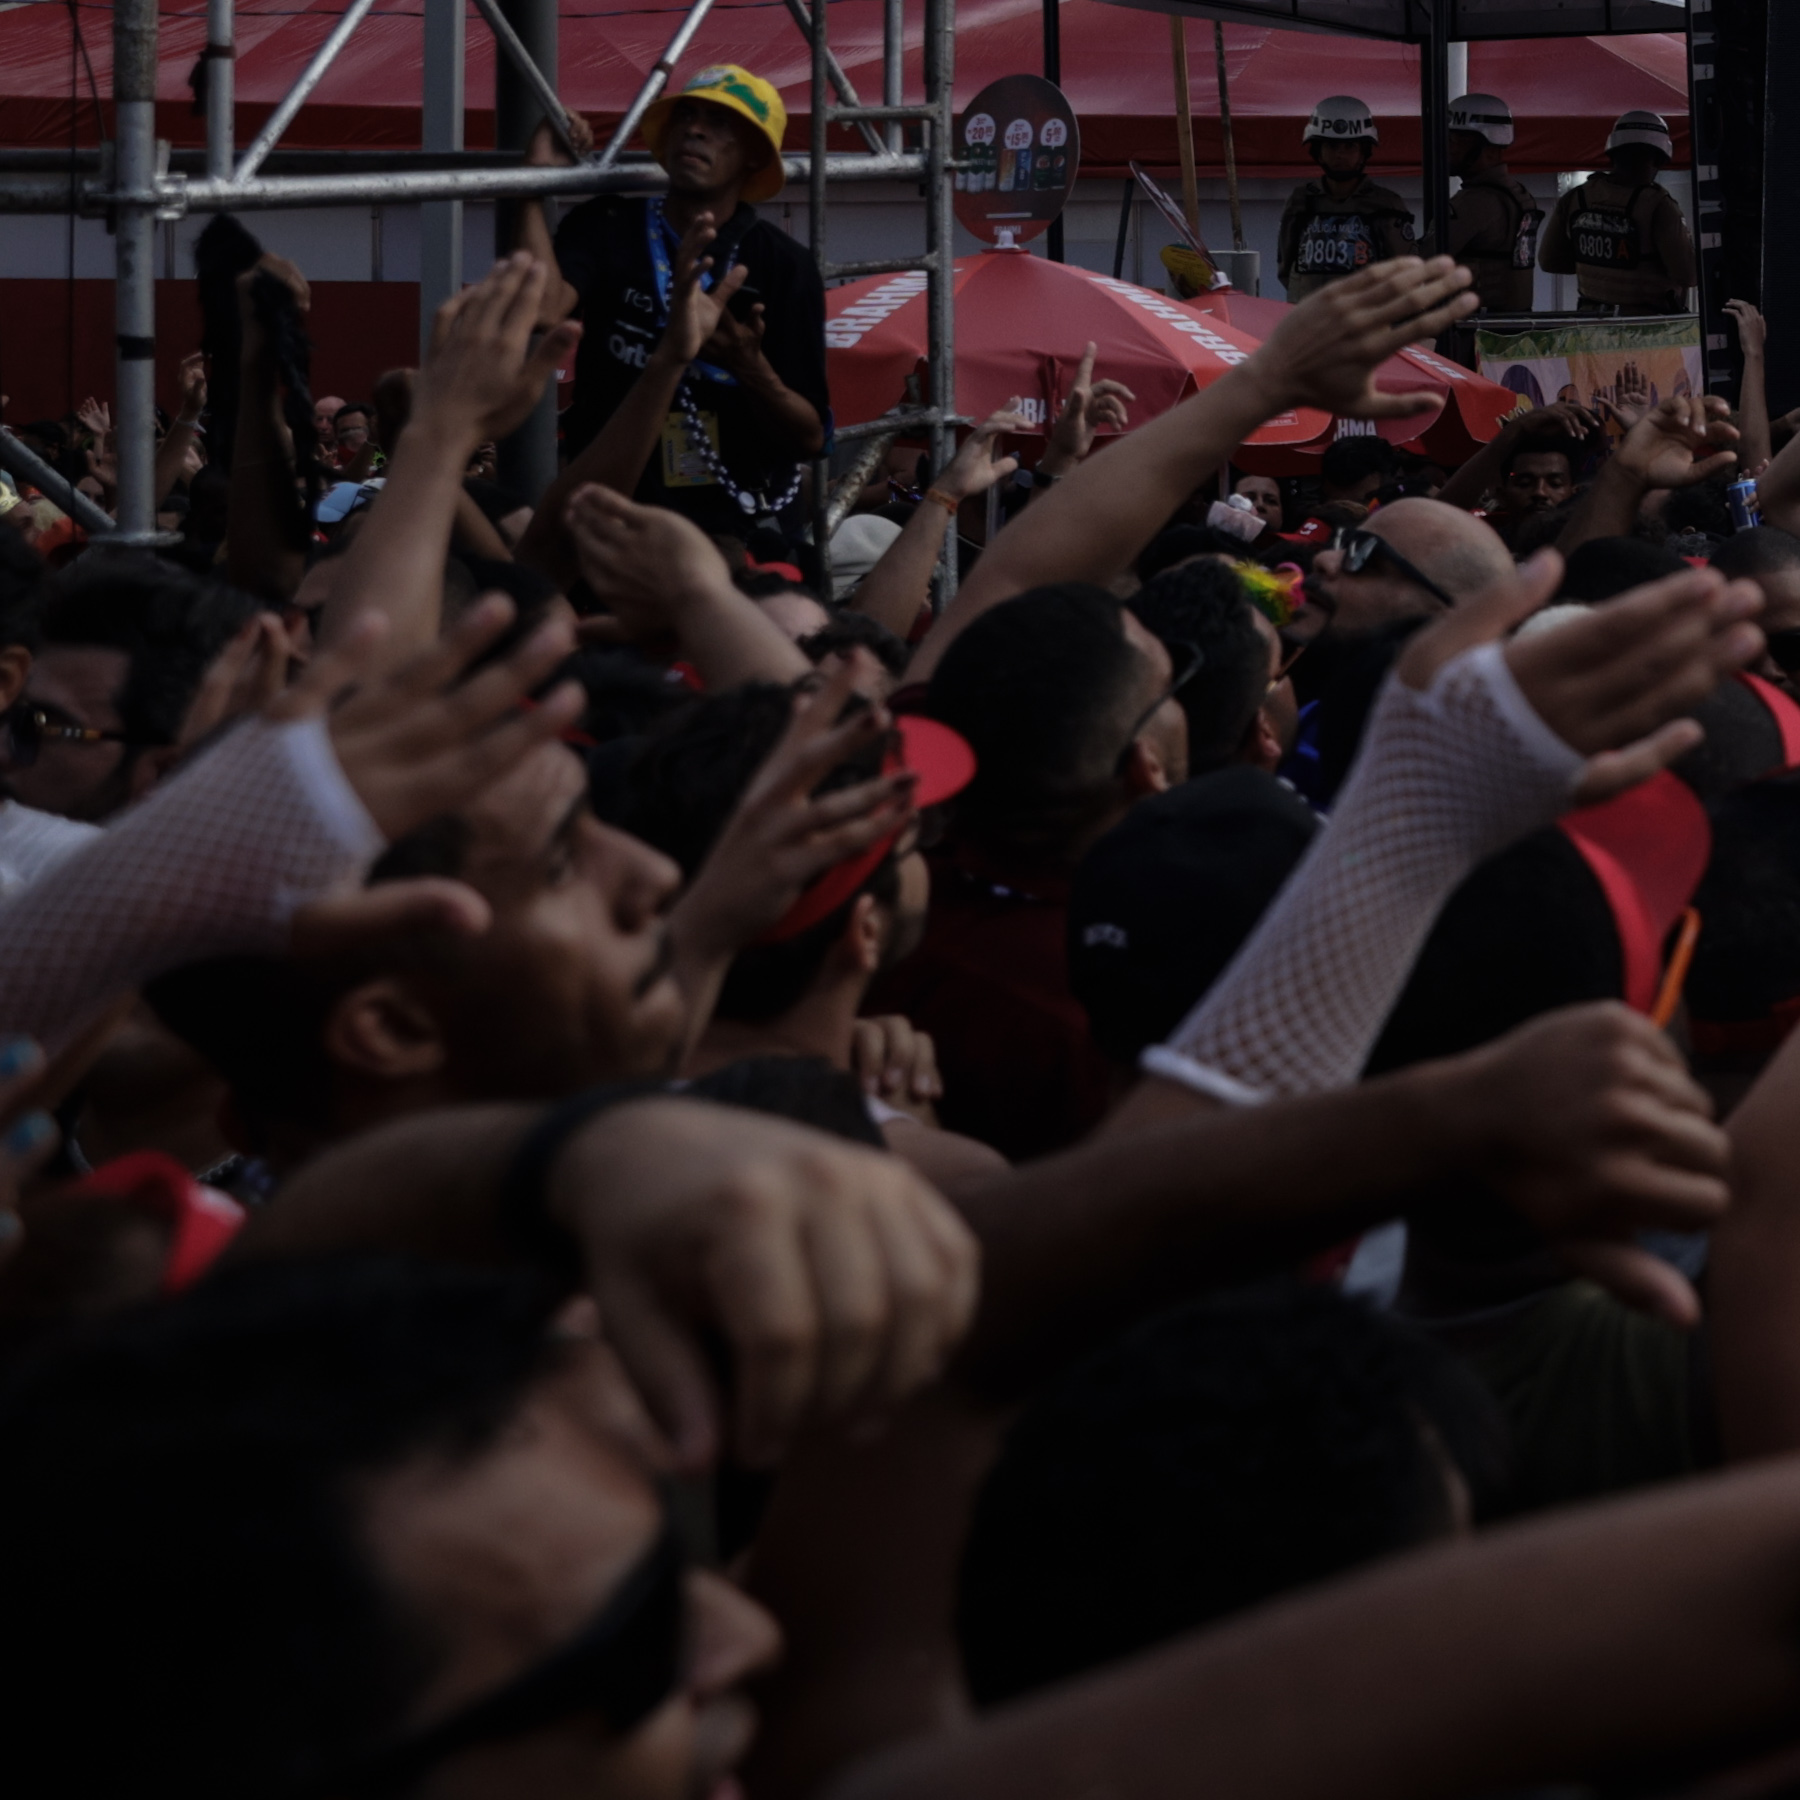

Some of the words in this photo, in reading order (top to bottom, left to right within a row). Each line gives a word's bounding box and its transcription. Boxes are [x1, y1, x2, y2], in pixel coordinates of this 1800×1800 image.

[1304, 238, 1348, 264] 0803
[1353, 240, 1369, 265] B
[1579, 233, 1613, 260] 0803
[1615, 239, 1631, 260] A
[1087, 276, 1249, 366] BRAHMA
